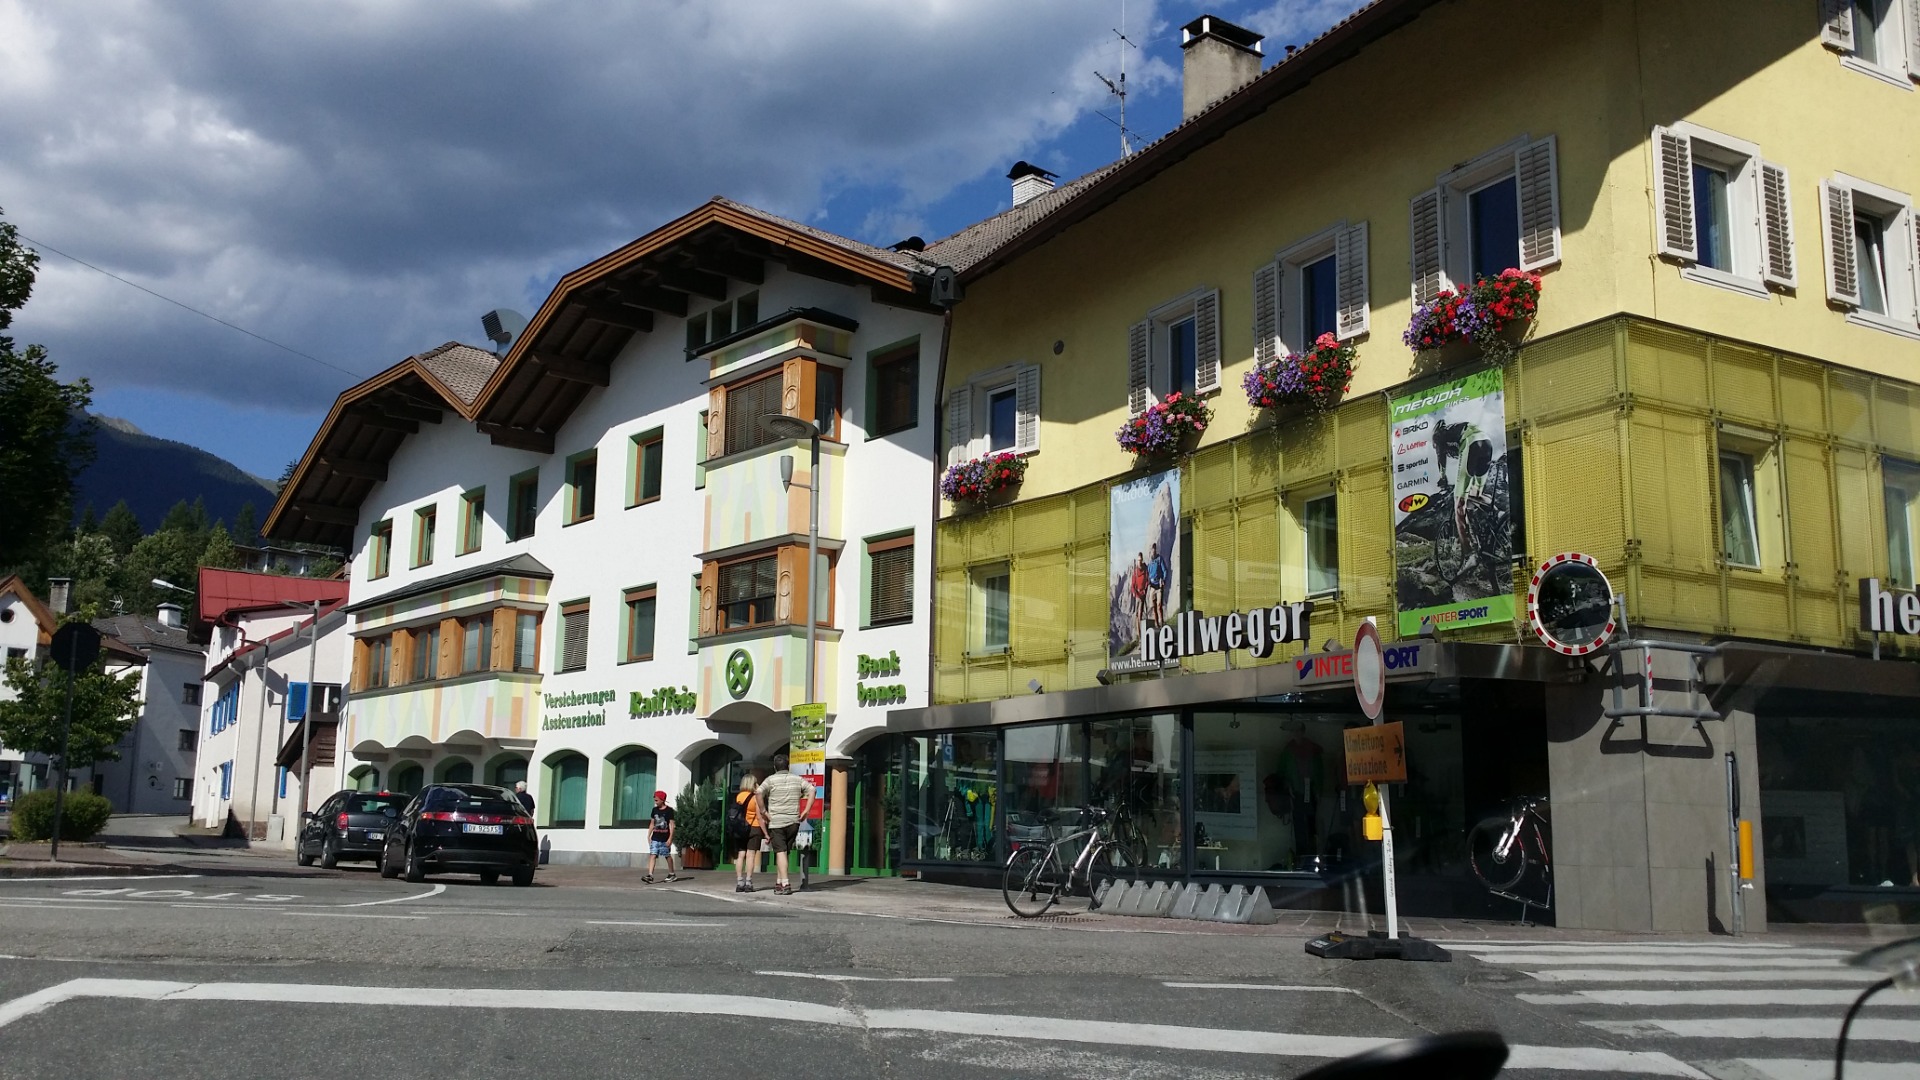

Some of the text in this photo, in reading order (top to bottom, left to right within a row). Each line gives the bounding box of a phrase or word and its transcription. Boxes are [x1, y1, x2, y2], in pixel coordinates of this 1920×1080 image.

[1394, 388, 1462, 417] MERIDA
[1403, 421, 1429, 436] BRIKO
[1405, 457, 1429, 471] sportful
[1112, 482, 1153, 504] Outdoo
[1397, 476, 1429, 490] GARMIN
[1403, 497, 1426, 509] NW
[1430, 606, 1489, 625] INTERSPORT
[1140, 602, 1308, 662] hellweger
[857, 650, 900, 674] Bank
[1315, 645, 1420, 678] INTEORT
[543, 688, 616, 709] Versicherungen
[629, 685, 698, 714] Raiffeis
[857, 682, 906, 702] banca
[542, 709, 606, 731] Assicurazioni
[1345, 734, 1384, 752] Umleitung
[1348, 757, 1388, 776] deviazione
[62, 888, 304, 901] STOP
